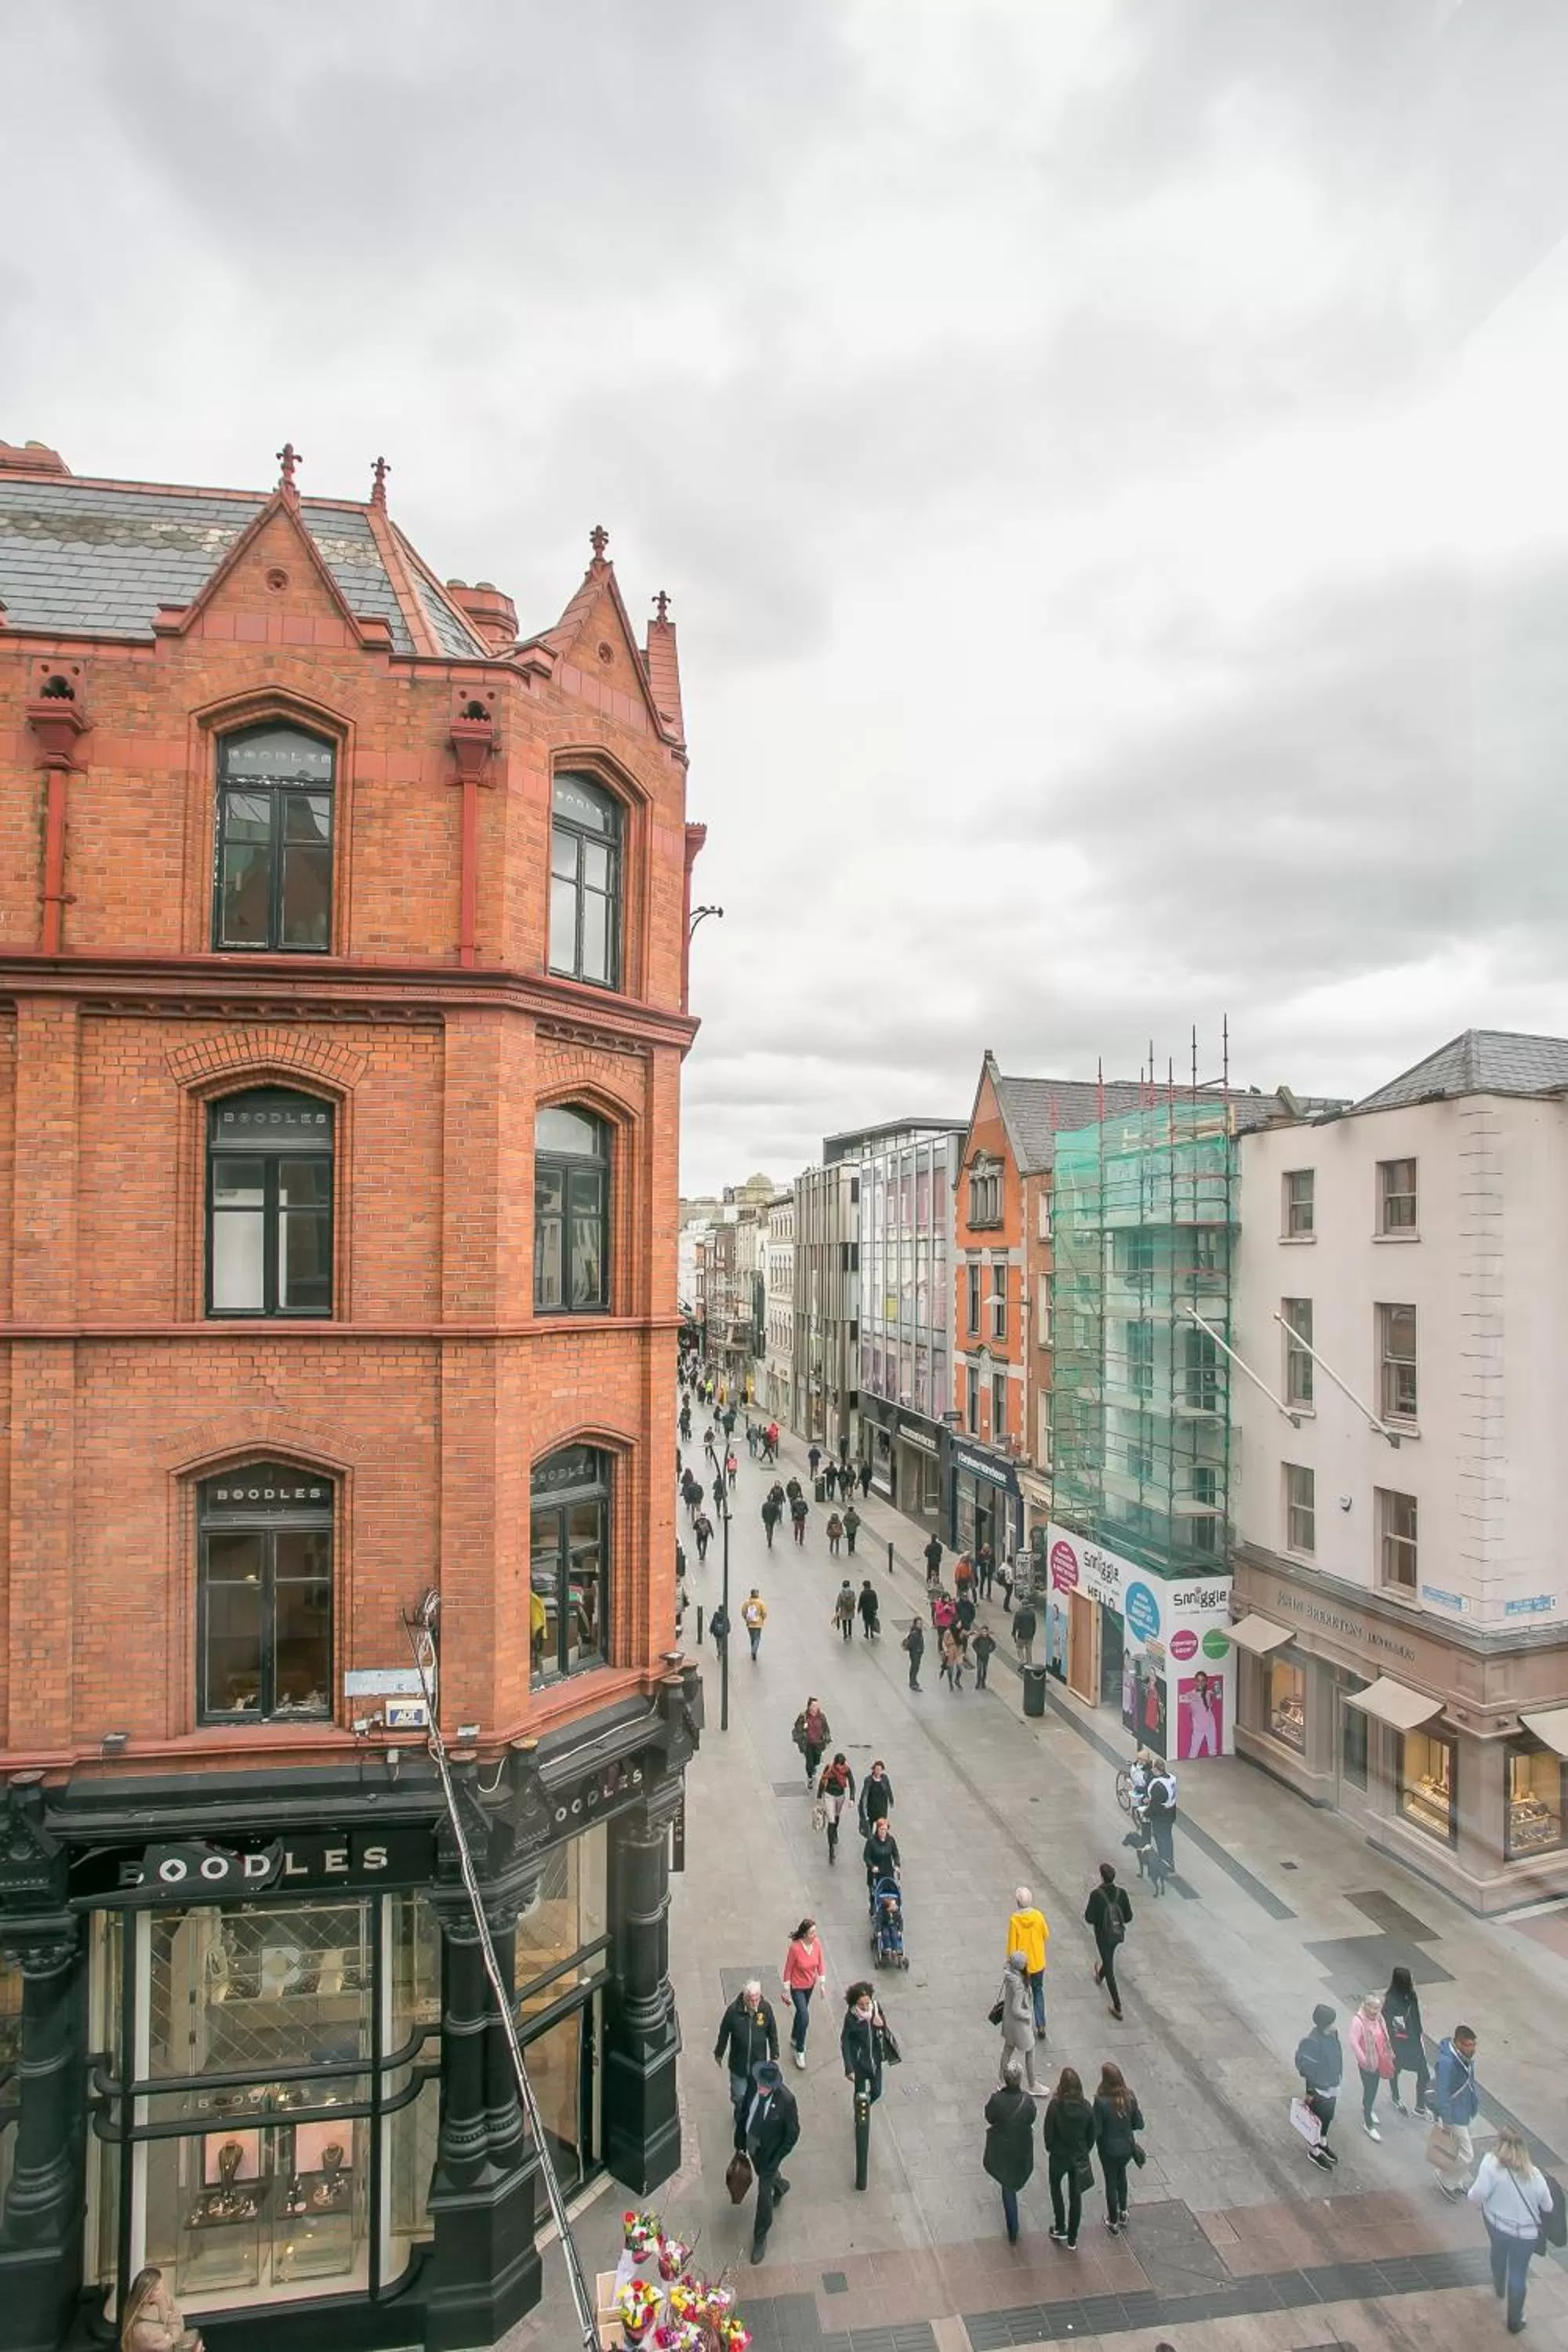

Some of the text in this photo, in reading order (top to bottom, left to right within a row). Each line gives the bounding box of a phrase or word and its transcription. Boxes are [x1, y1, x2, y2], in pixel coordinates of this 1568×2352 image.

[223, 1112, 327, 1124] BOODLES
[217, 1487, 321, 1501] BOODLES
[394, 1710, 417, 1723] ADT
[118, 1846, 389, 1885] BOODLES
